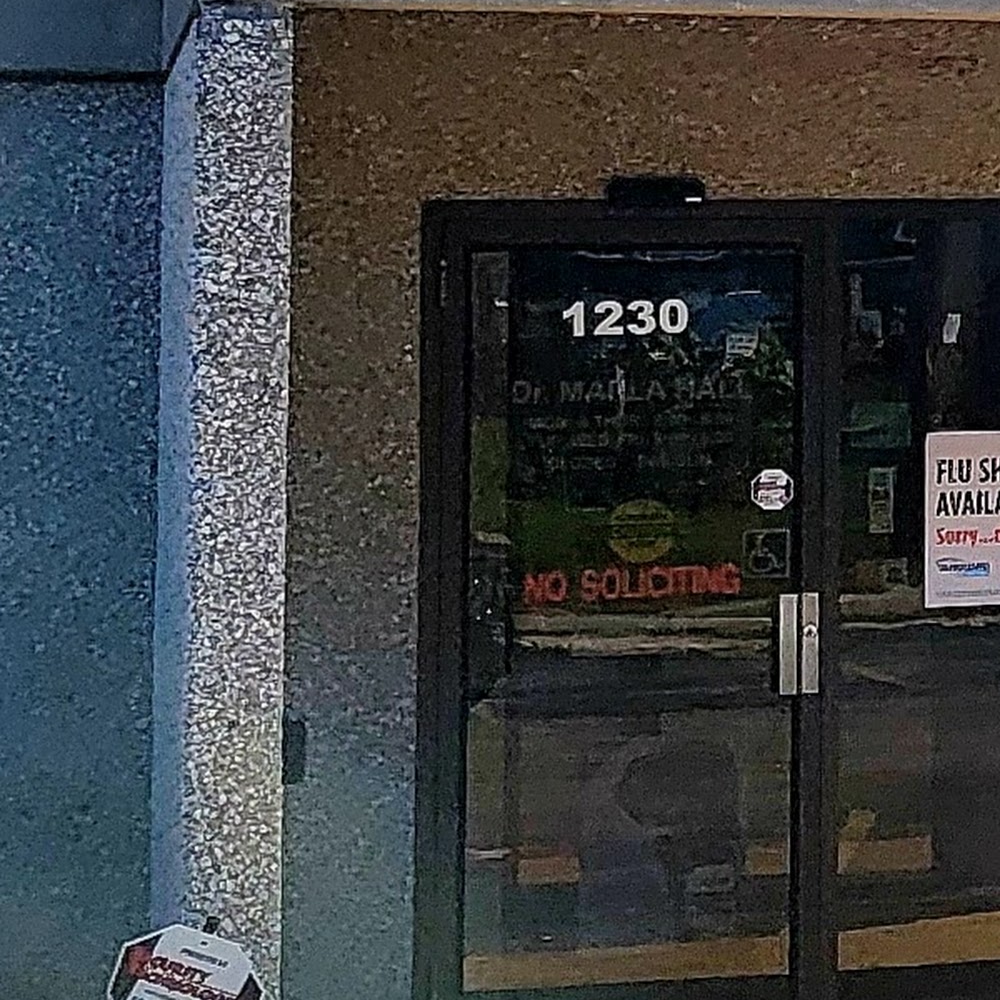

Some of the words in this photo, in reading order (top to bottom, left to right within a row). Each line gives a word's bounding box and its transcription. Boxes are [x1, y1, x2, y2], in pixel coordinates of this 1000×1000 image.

[562, 299, 689, 337] 1230
[936, 459, 972, 485] FLU
[523, 569, 569, 604] NO
